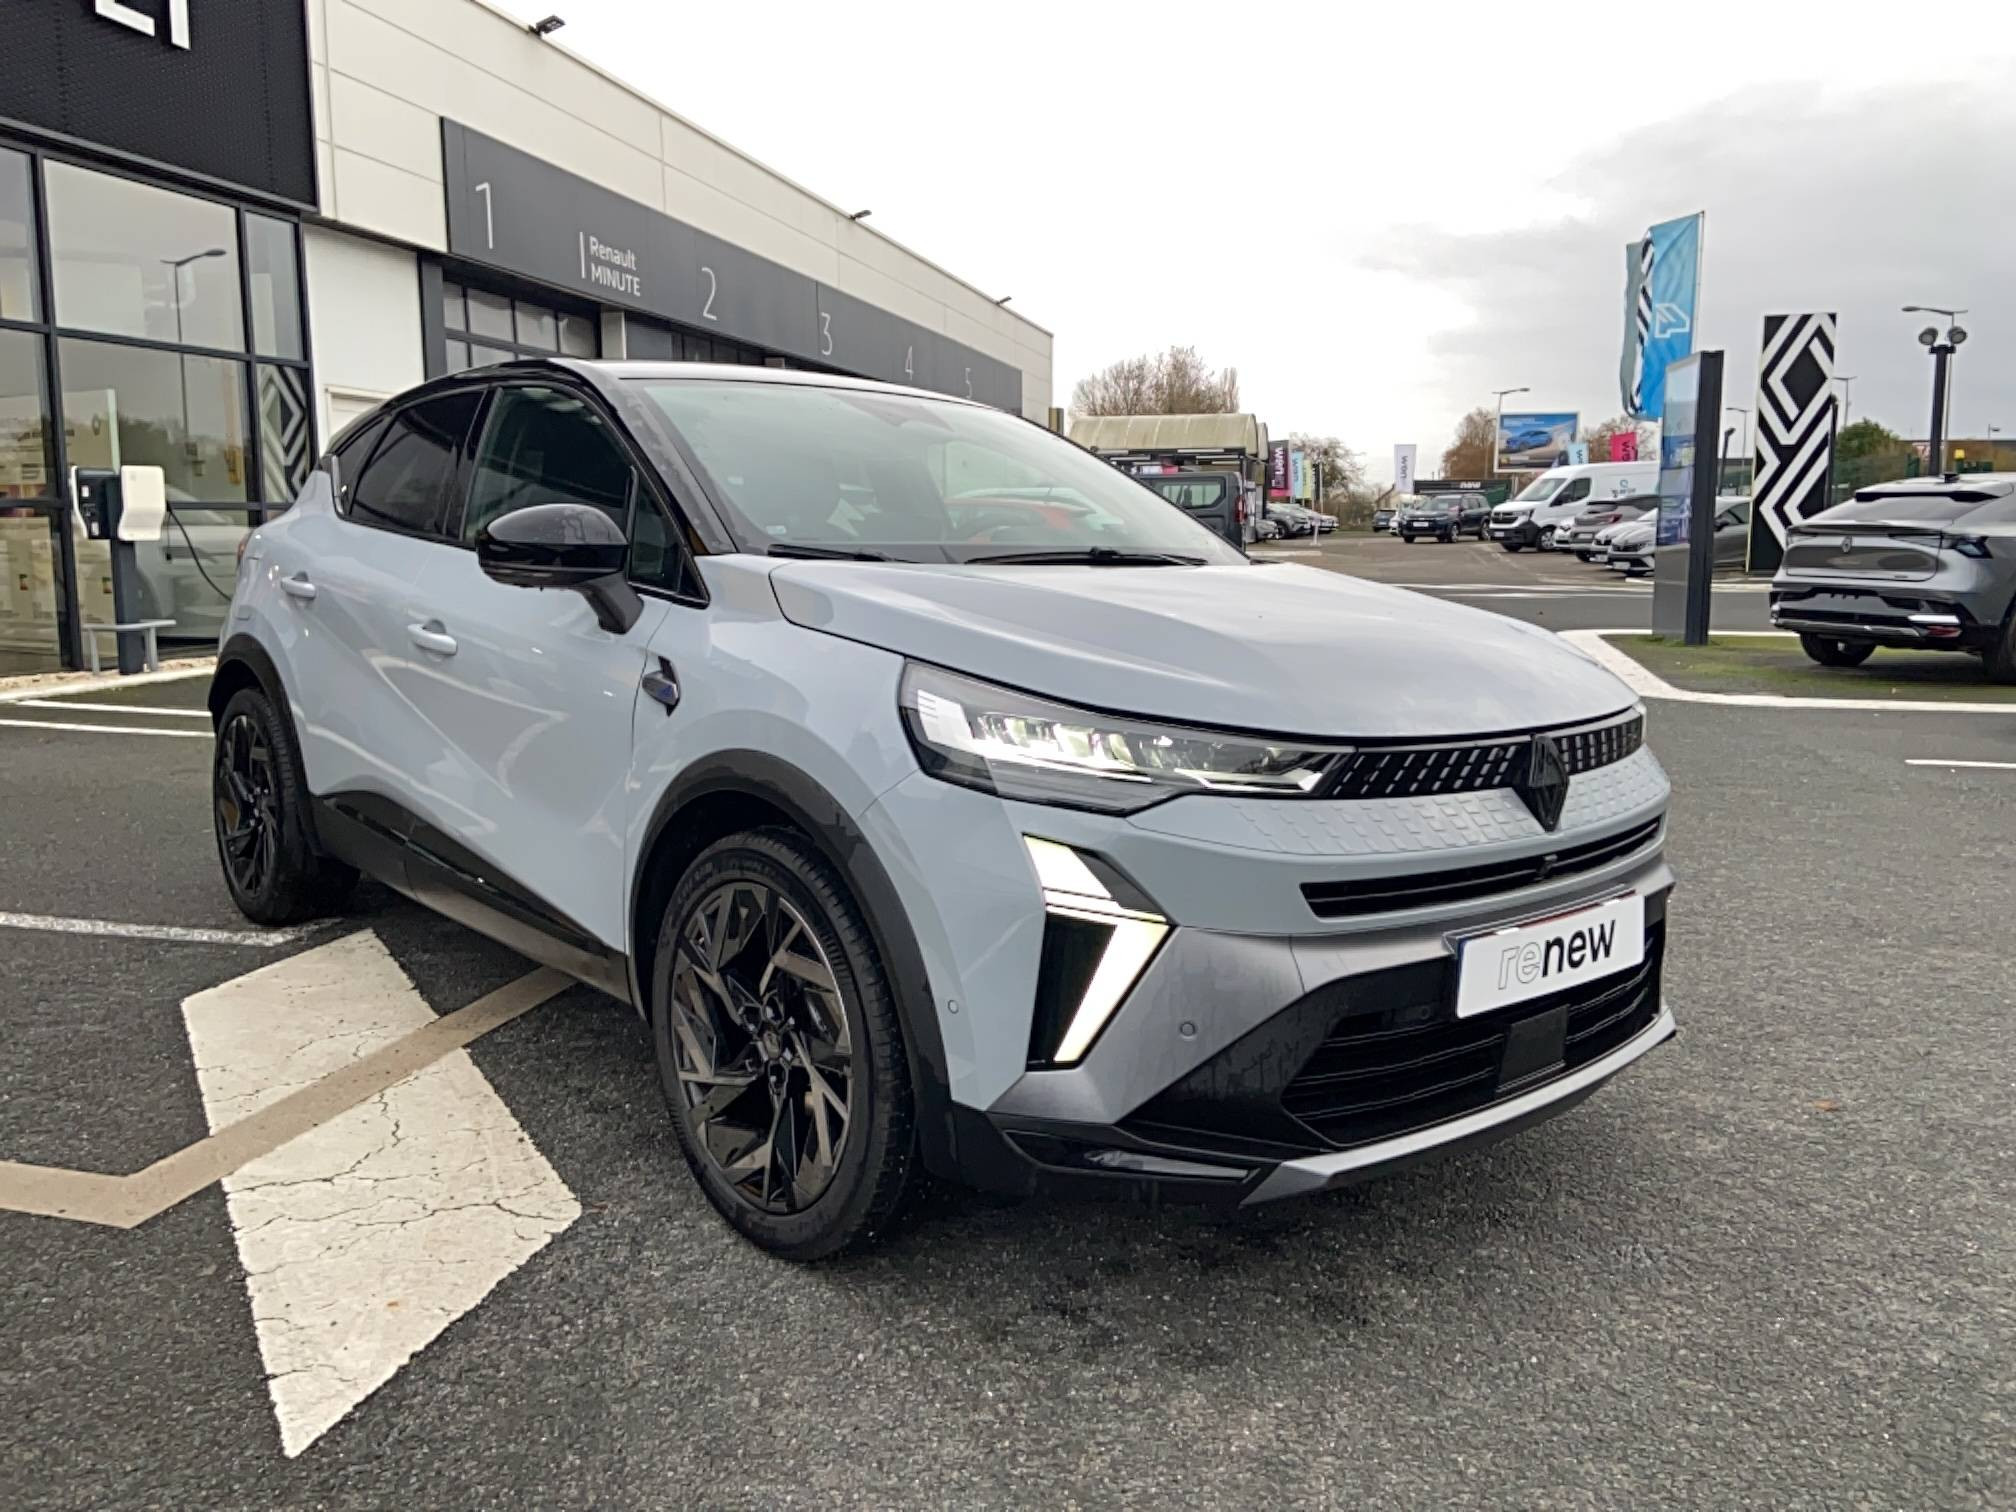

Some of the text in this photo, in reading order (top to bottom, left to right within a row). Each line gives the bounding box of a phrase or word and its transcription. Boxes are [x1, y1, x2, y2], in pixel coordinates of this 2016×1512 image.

[475, 182, 494, 249] 1
[589, 235, 637, 271] Renault
[591, 262, 641, 297] MINUTE
[701, 266, 718, 321] 2
[821, 311, 833, 355] 3
[904, 345, 914, 381] 4
[964, 367, 973, 399] 5
[1497, 919, 1616, 990] renew
